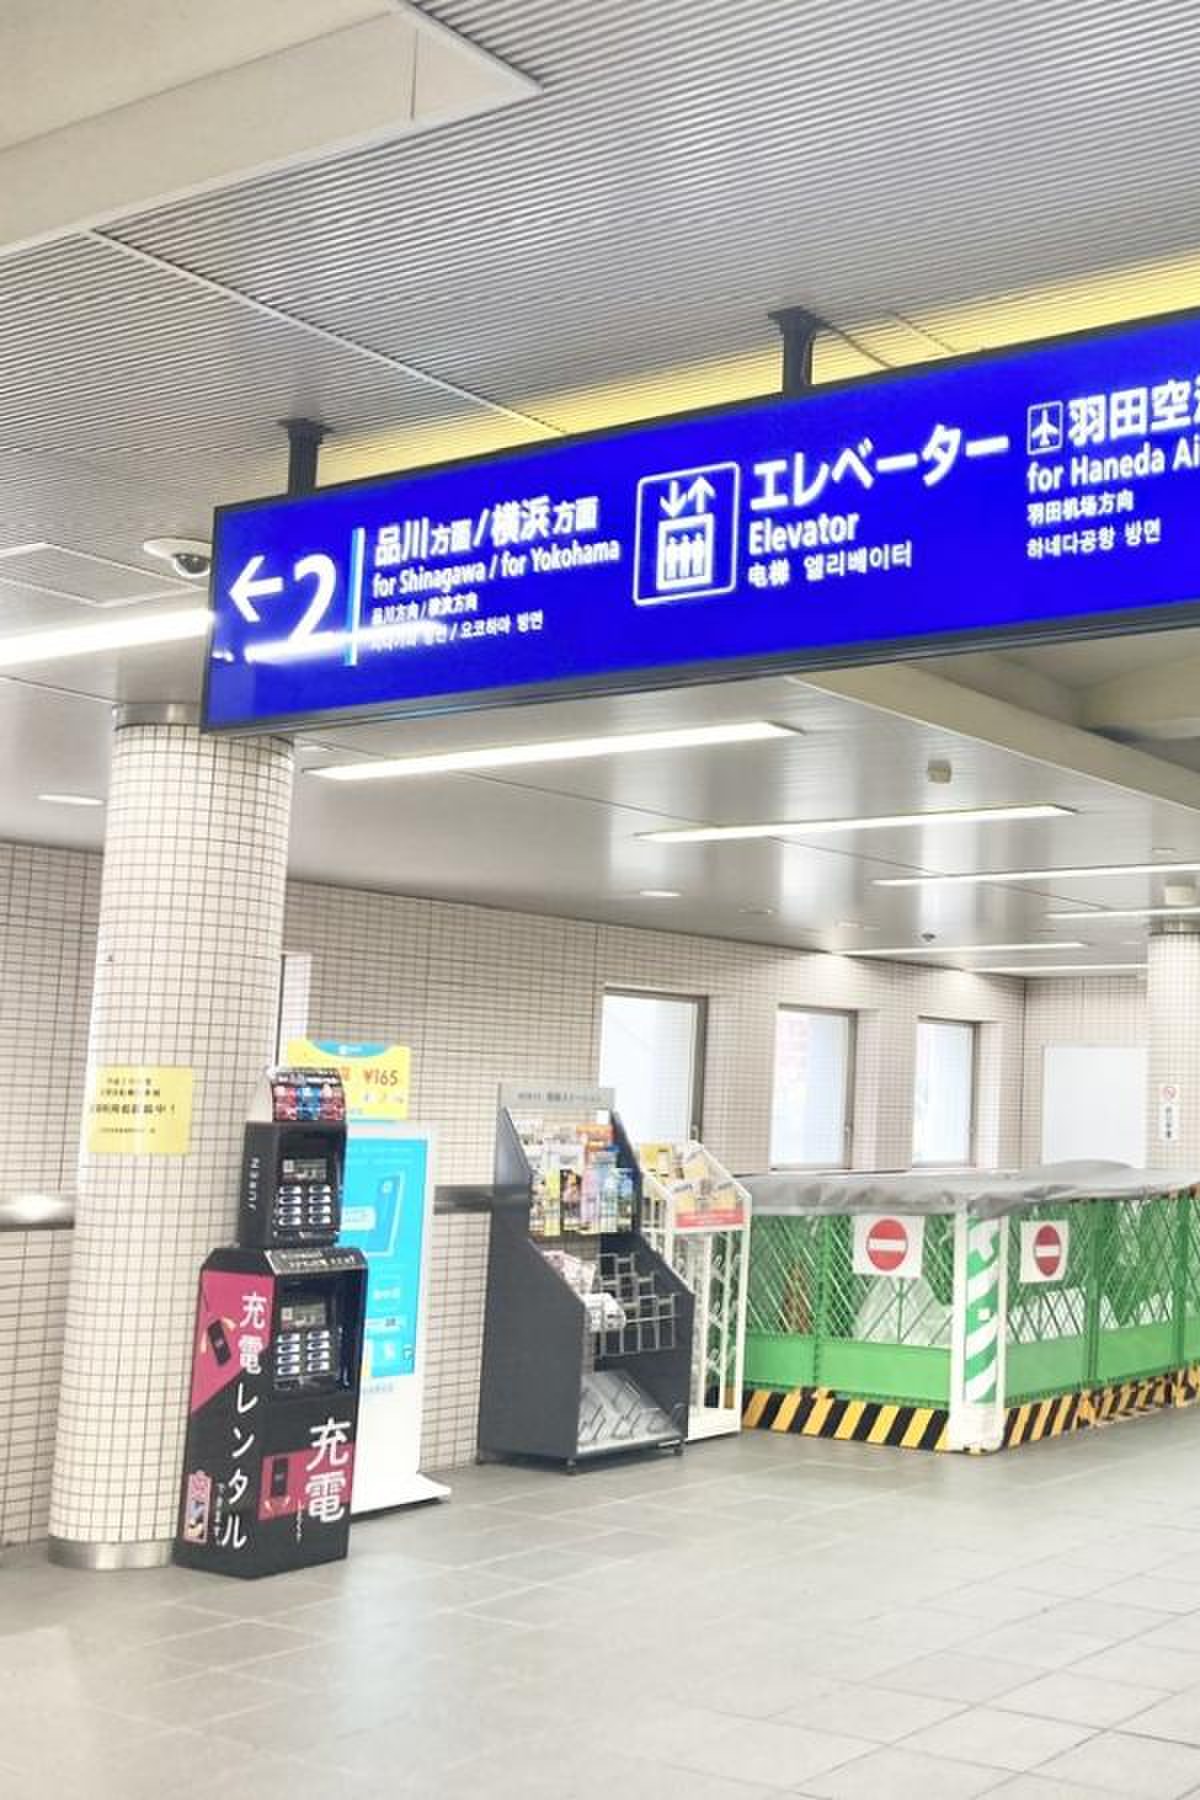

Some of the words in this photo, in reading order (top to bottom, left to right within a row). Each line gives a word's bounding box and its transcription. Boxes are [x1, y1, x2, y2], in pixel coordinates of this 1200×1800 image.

[749, 423, 1010, 511] エレベーター
[1027, 462, 1064, 493] for
[1071, 442, 1165, 486] Haneda
[372, 572, 398, 599] for
[399, 557, 486, 595] Shinagawa
[501, 549, 526, 574] for
[530, 538, 621, 573] Yokohama
[748, 513, 859, 555] Elevator
[803, 540, 913, 583] 엘리베이터
[291, 553, 337, 650] 2
[221, 1290, 267, 1549] 充電レンタル
[306, 1417, 352, 1523] 充電
